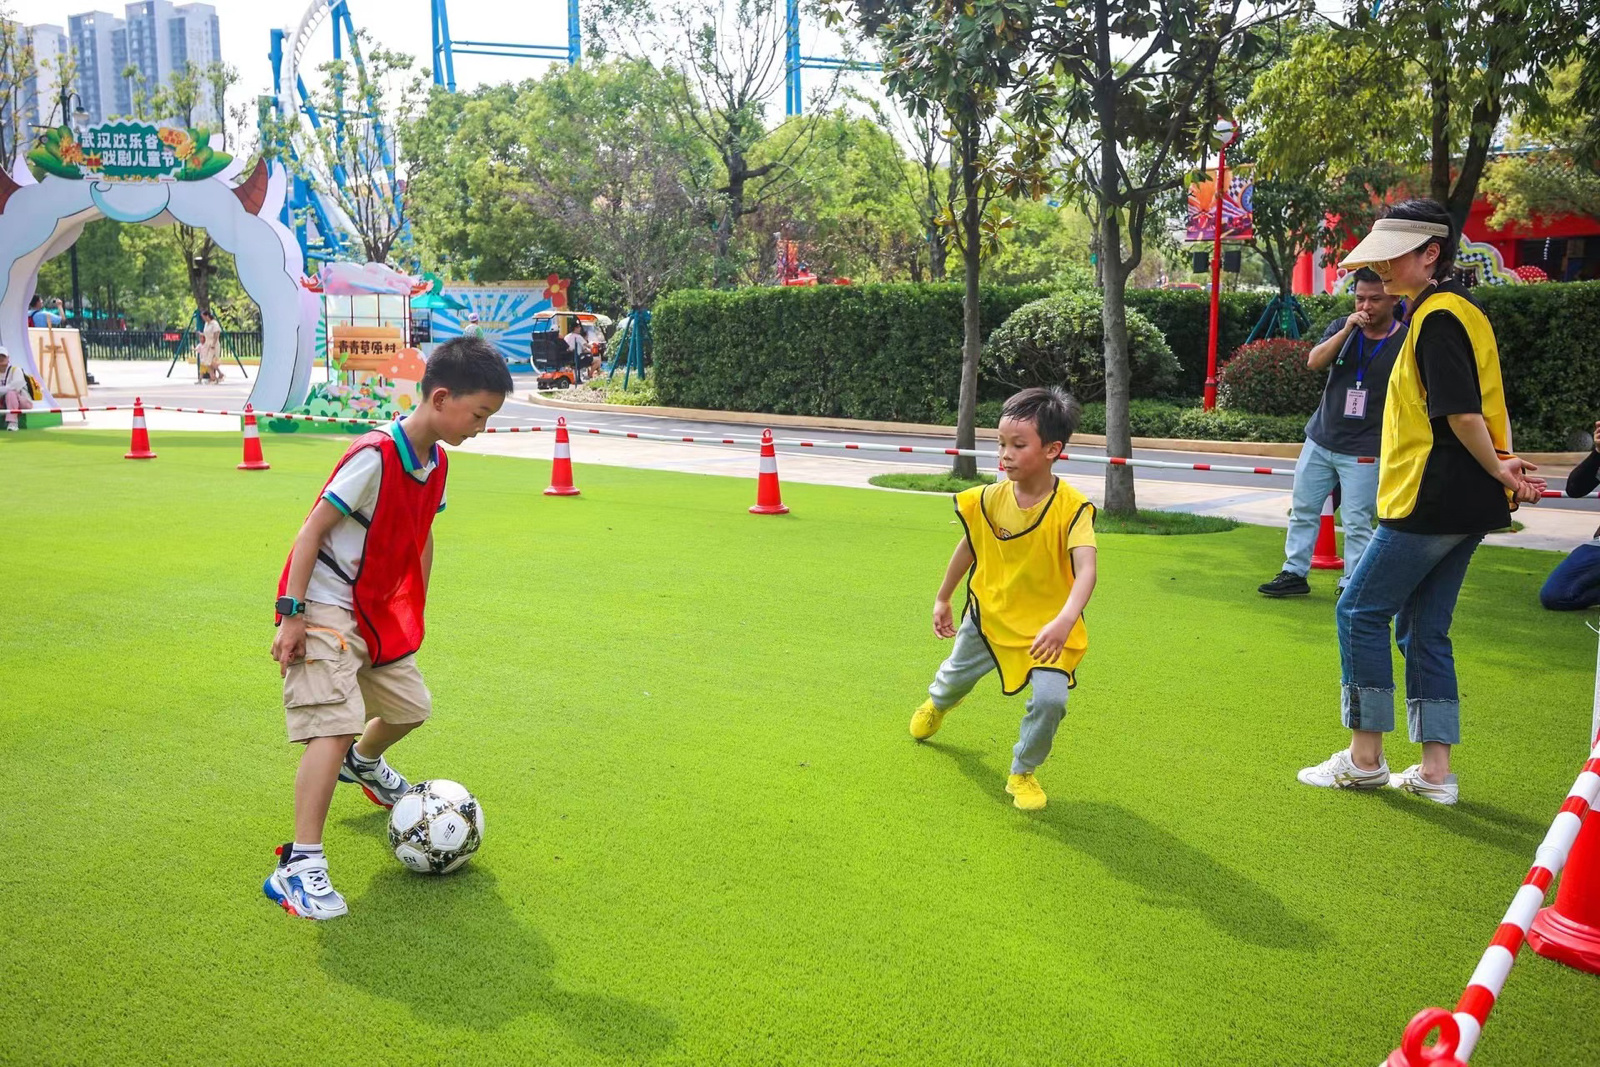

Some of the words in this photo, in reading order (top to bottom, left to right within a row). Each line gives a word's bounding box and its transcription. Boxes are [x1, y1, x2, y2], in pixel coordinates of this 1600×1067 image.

[81, 132, 158, 149] 武汉欢乐谷
[102, 149, 174, 167] 戏剧儿童节
[338, 340, 396, 355] 青青草原村
[448, 822, 456, 834] 5
